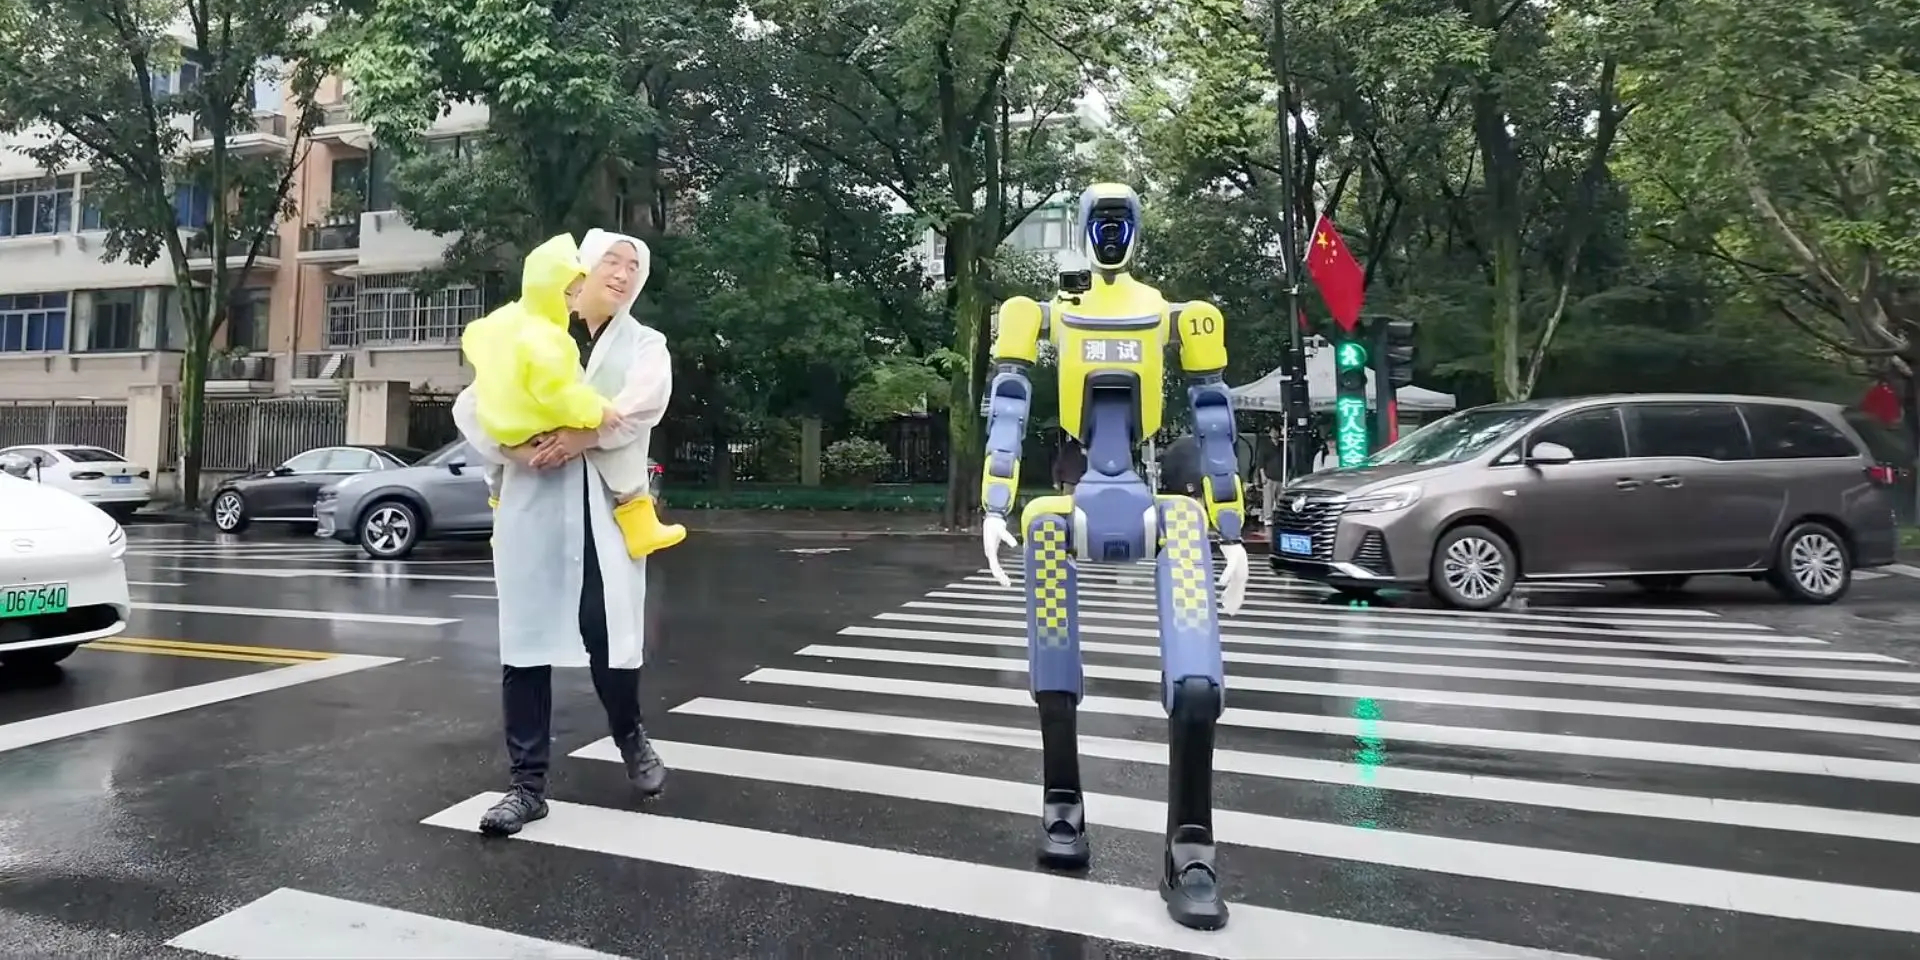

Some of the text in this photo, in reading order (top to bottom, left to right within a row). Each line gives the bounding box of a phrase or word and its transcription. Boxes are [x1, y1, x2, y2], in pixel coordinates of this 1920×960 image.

[1189, 317, 1214, 335] 10
[1086, 339, 1139, 361] 测试
[6, 587, 67, 612] D67540
